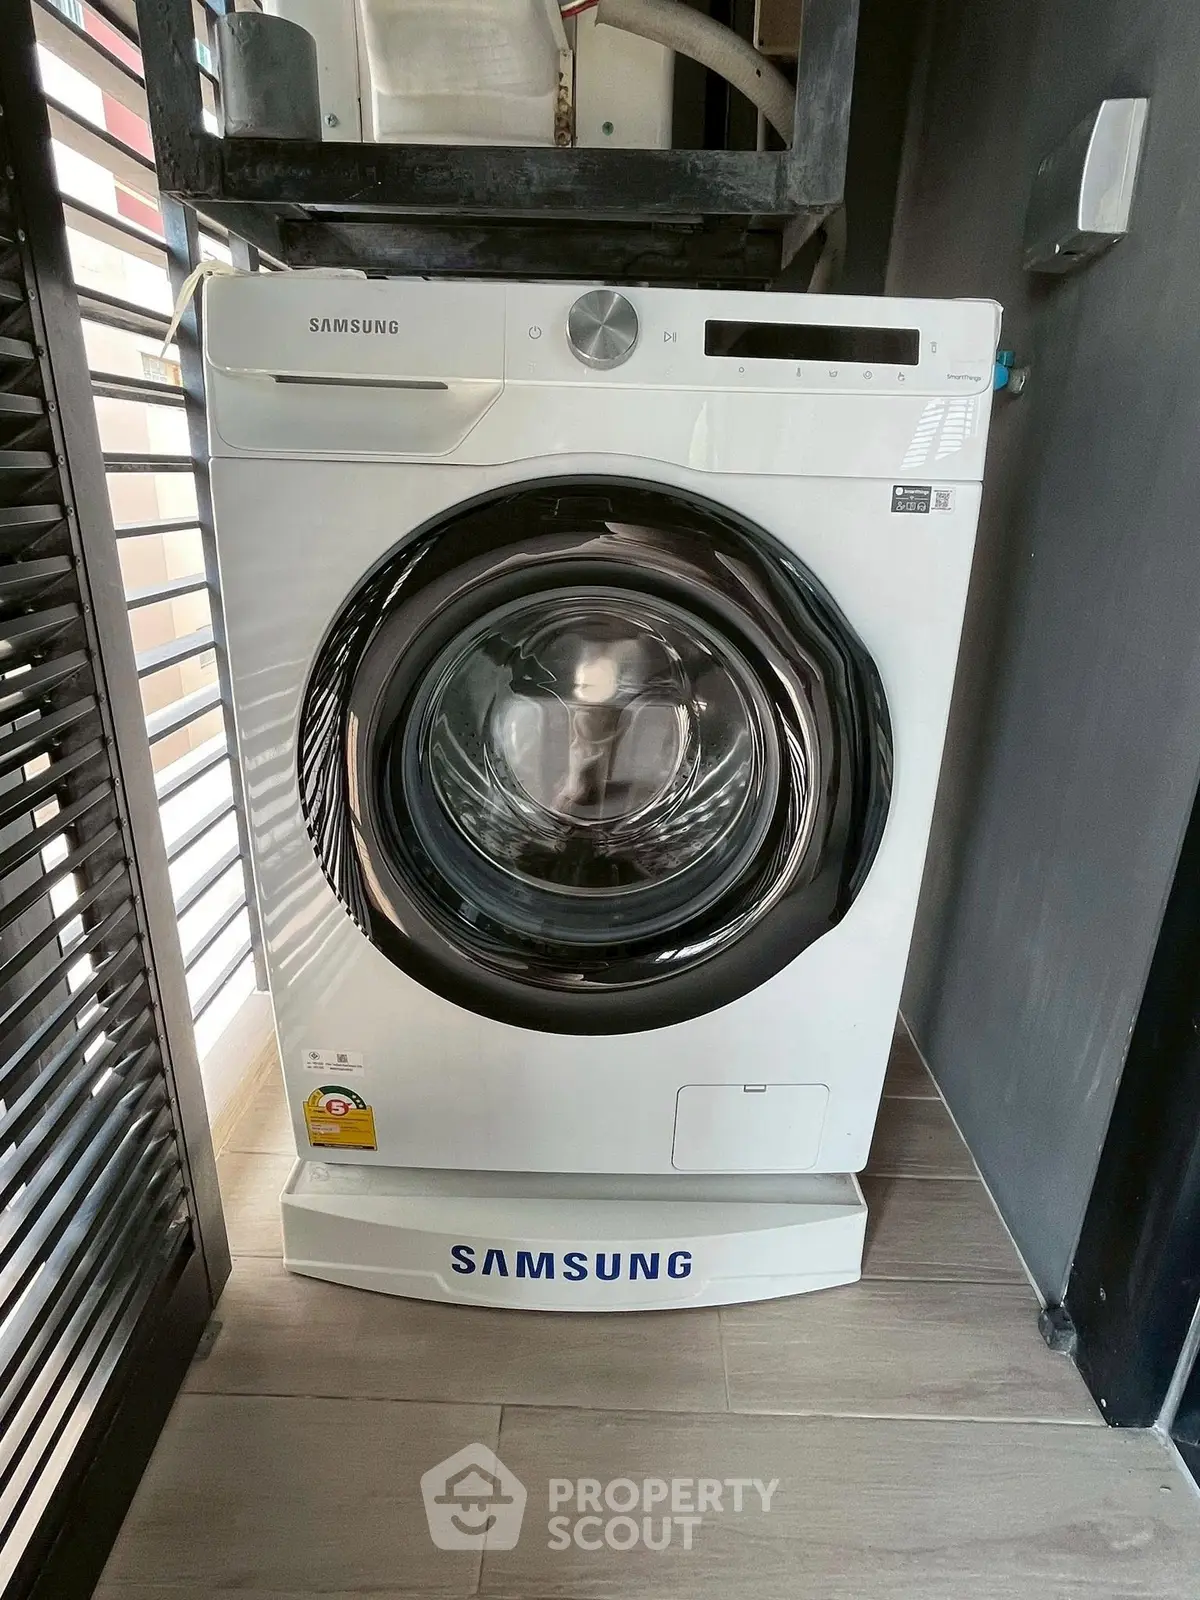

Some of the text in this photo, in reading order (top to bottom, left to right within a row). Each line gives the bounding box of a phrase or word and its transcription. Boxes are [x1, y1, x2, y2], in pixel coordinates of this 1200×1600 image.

[309, 317, 399, 335] SAMSUNG
[330, 1100, 345, 1116] 5
[451, 1244, 693, 1281] SAMSUNG
